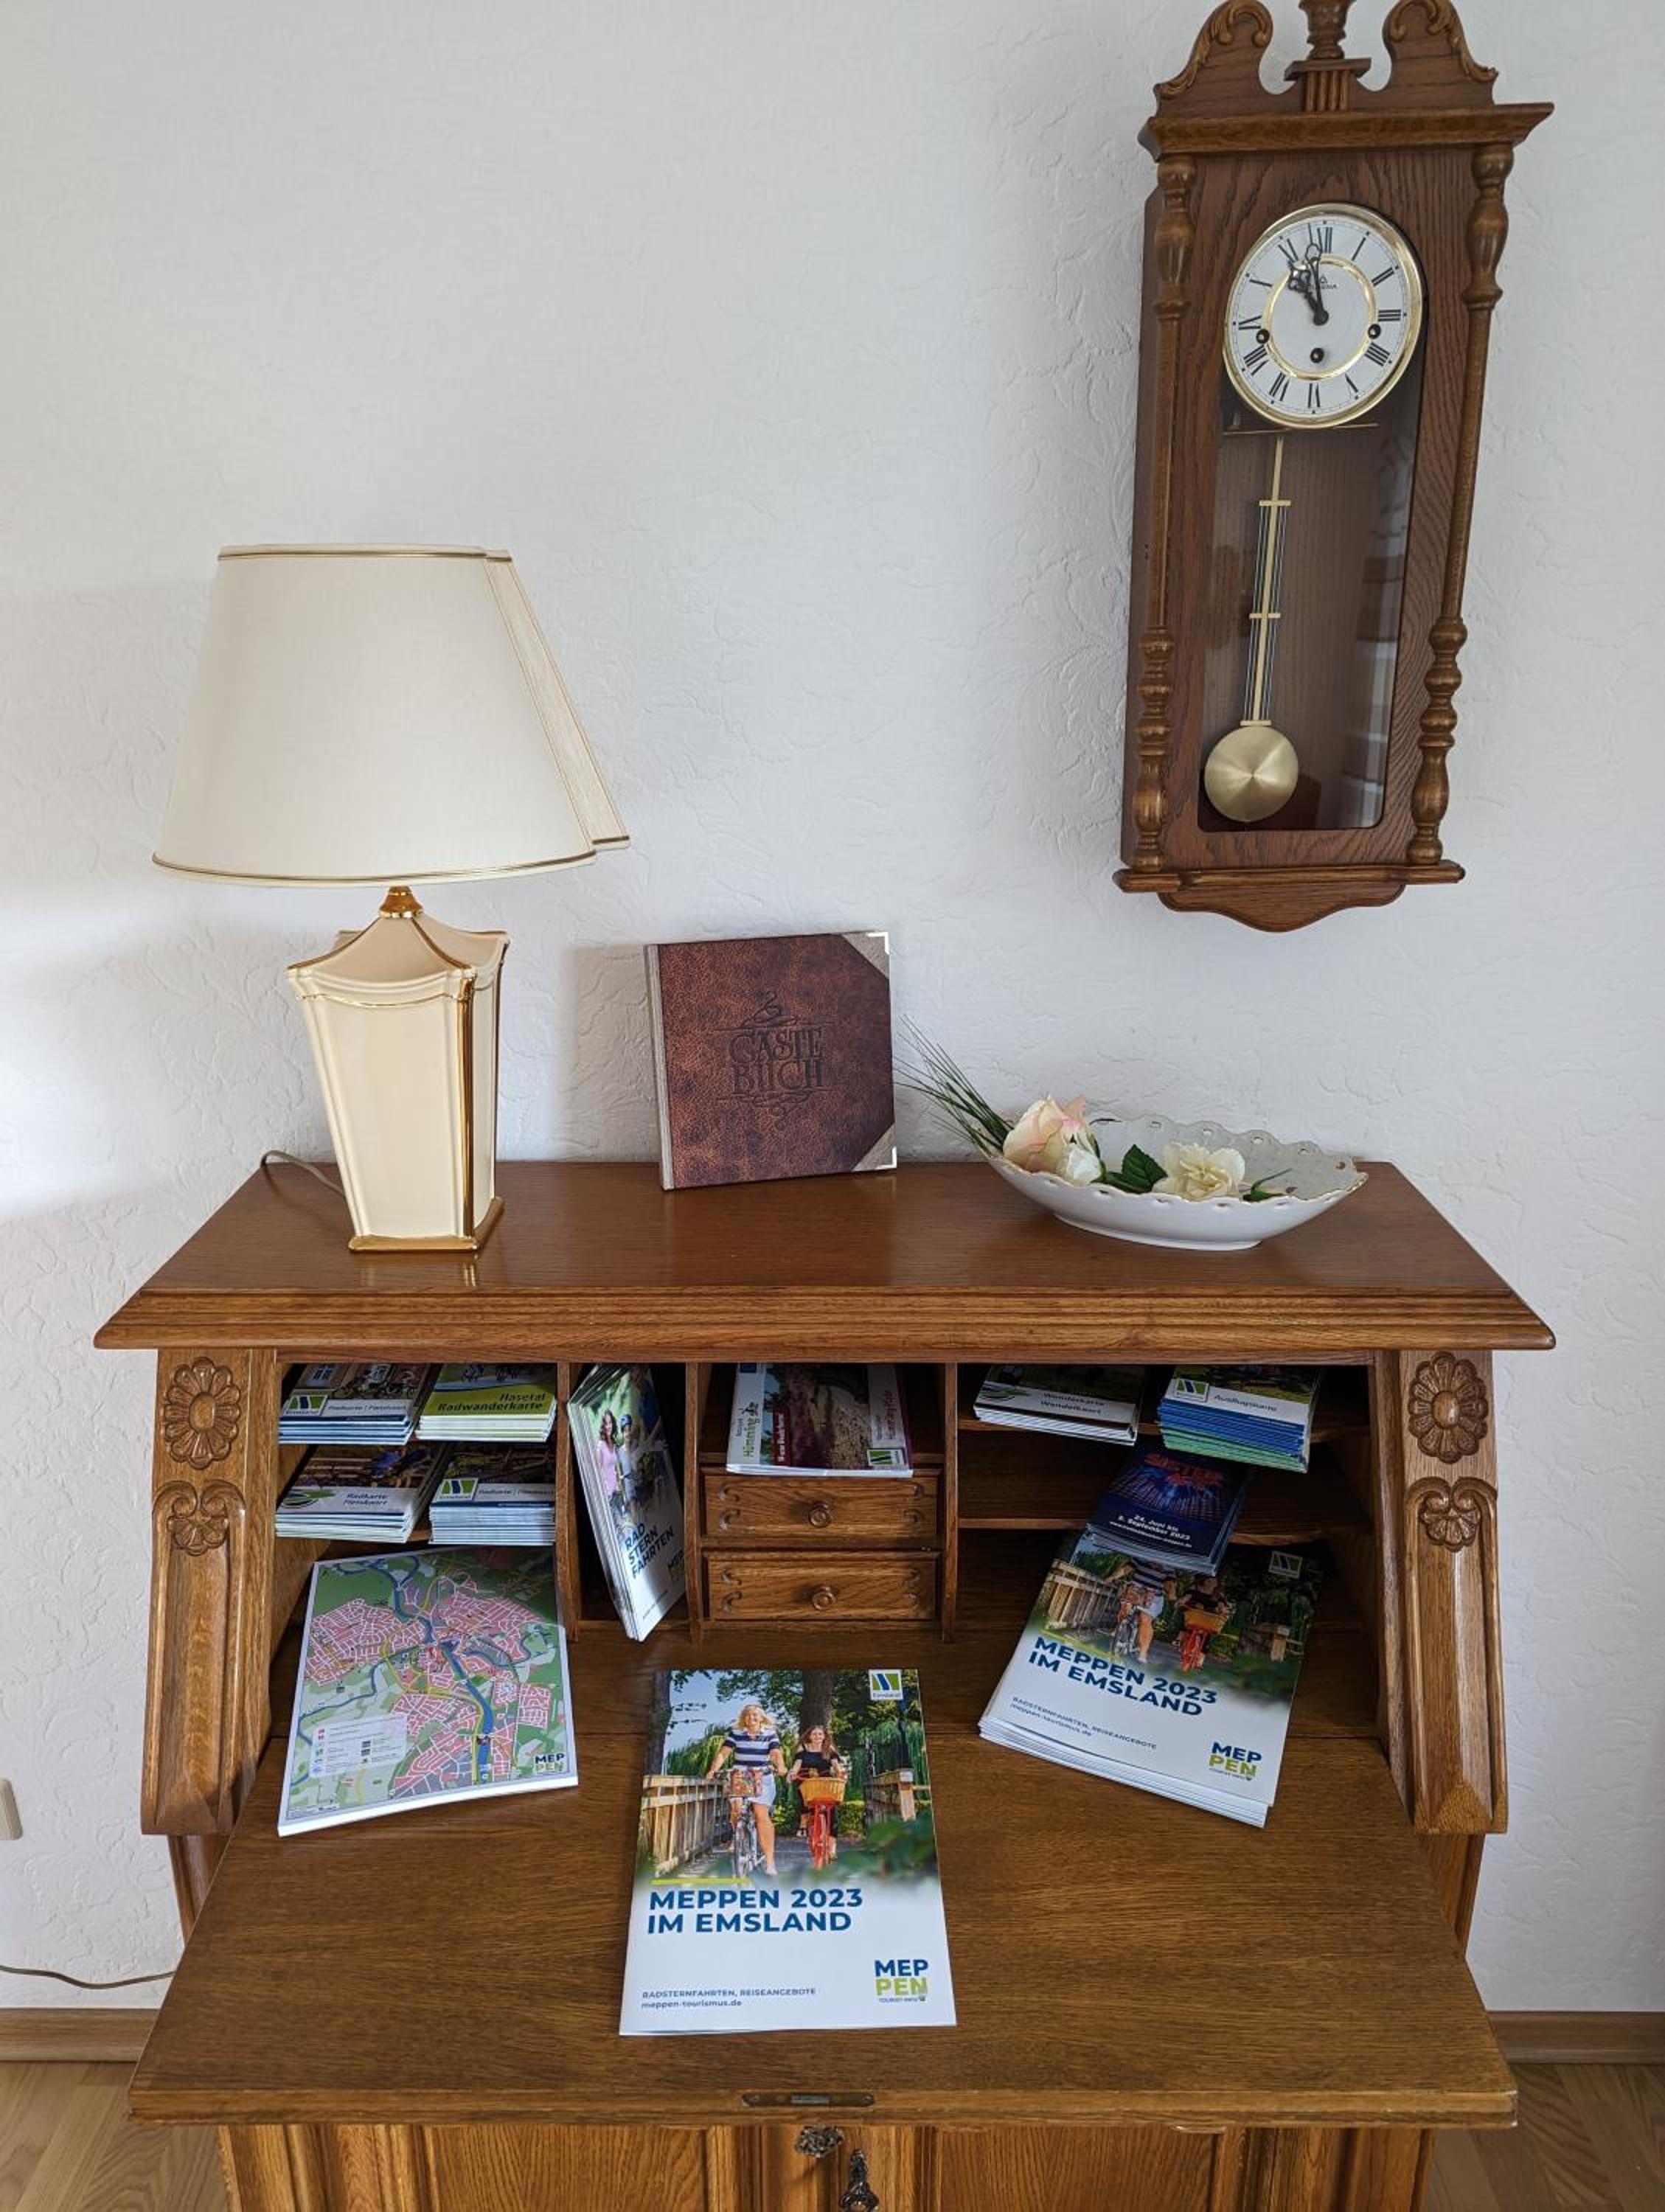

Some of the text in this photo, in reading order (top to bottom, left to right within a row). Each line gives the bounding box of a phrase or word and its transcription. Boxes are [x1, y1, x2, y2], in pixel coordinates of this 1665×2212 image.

[1371, 266, 1394, 287] II
[1378, 308, 1401, 322] III
[732, 1060, 824, 1095] BUCH
[437, 1402, 543, 1411] Radwanderkarte
[500, 1392, 546, 1402] Hasetal
[625, 1522, 646, 1551] RAD
[628, 1525, 658, 1565] STERN
[632, 1526, 673, 1579] FAHRTEN
[1035, 1637, 1217, 1704] MEPPEN 2023
[1029, 1652, 1202, 1716] IM EMSLAND
[1092, 1725, 1158, 1750] REISEANGEBOTE
[535, 1753, 565, 1764] MEP
[1212, 1742, 1262, 1763] MEP
[1209, 1754, 1257, 1776] PEN
[650, 1888, 863, 1910] MEPPEN 2023
[647, 1912, 852, 1934] IM EMSLAND
[875, 1959, 928, 1977] MEP
[642, 1987, 816, 1999] RADSTERNFAHRTEN, REISEANGEBOTE
[875, 1977, 928, 1997] PEN
[642, 1999, 743, 2010] meppen-tourismus.de
